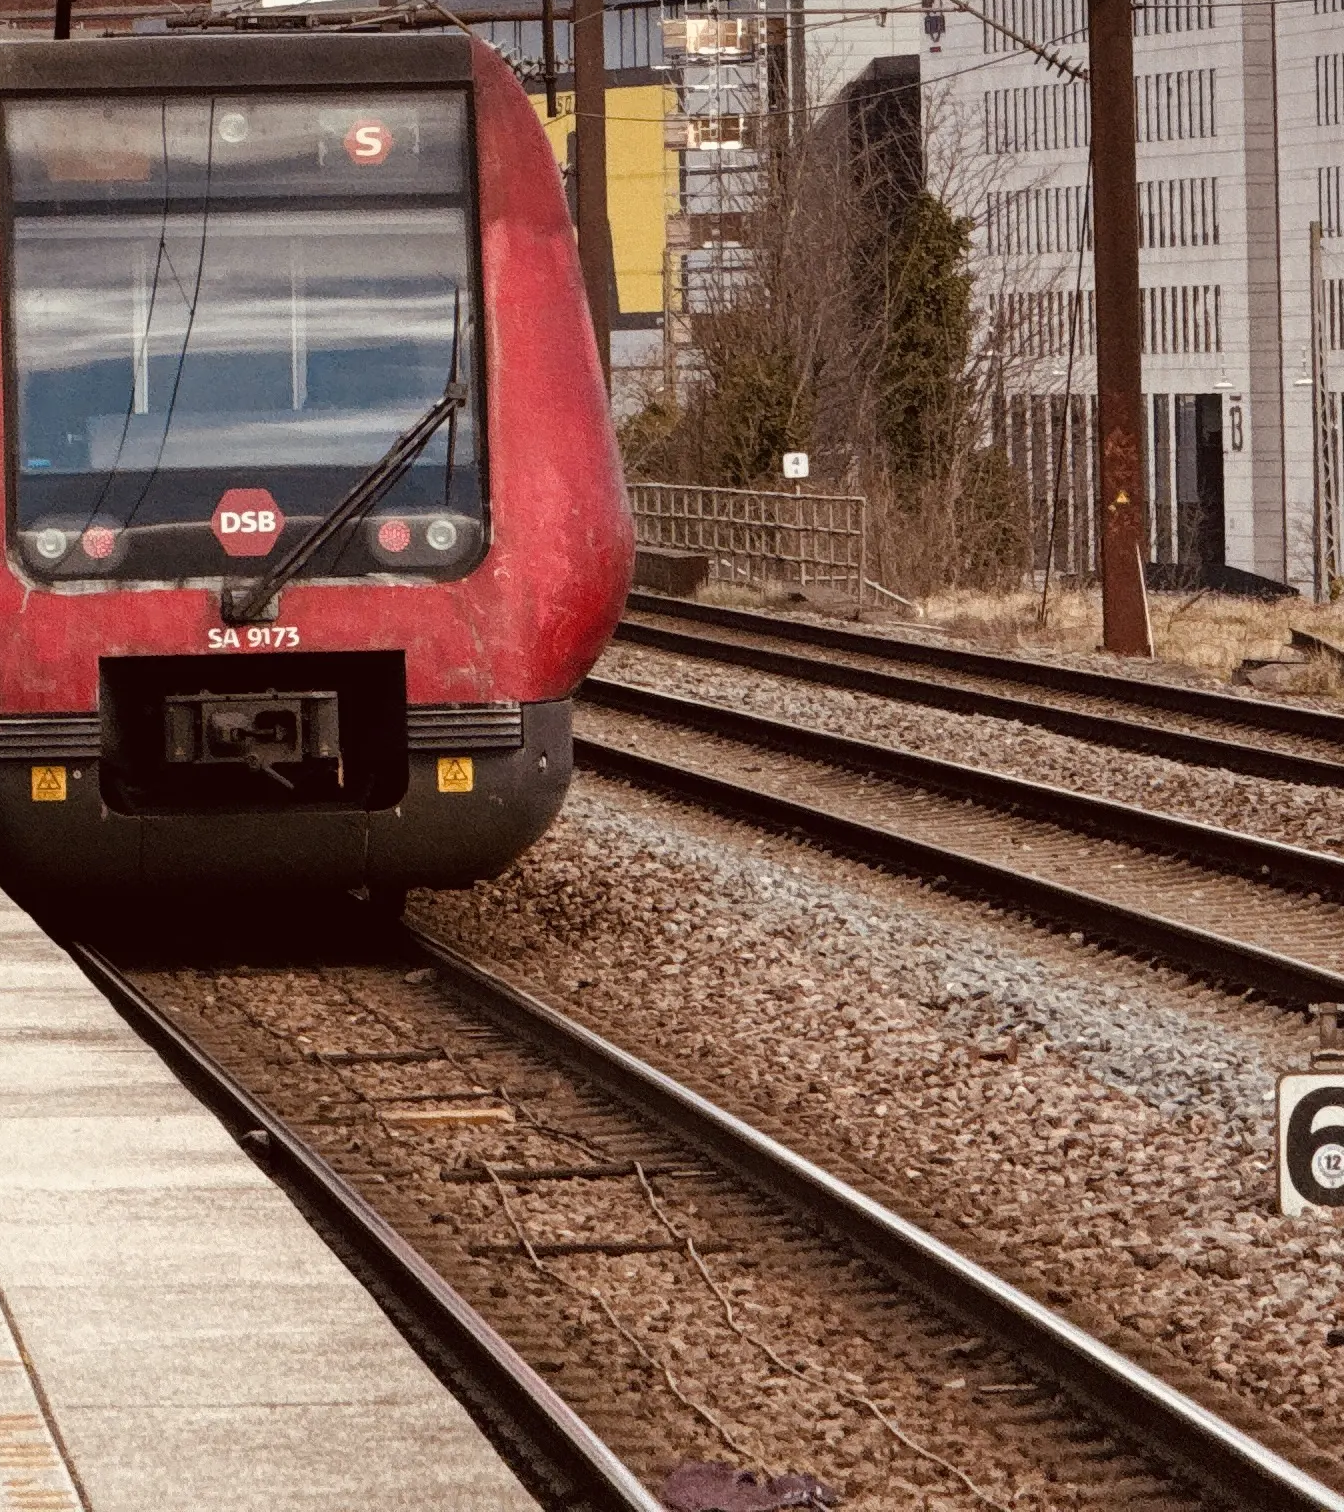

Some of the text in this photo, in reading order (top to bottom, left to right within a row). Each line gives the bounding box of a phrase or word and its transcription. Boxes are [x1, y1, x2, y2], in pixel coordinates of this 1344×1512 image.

[355, 126, 382, 156] S
[220, 510, 276, 534] DSB
[207, 626, 300, 649] SA 9173
[1324, 1154, 1342, 1171] 12
